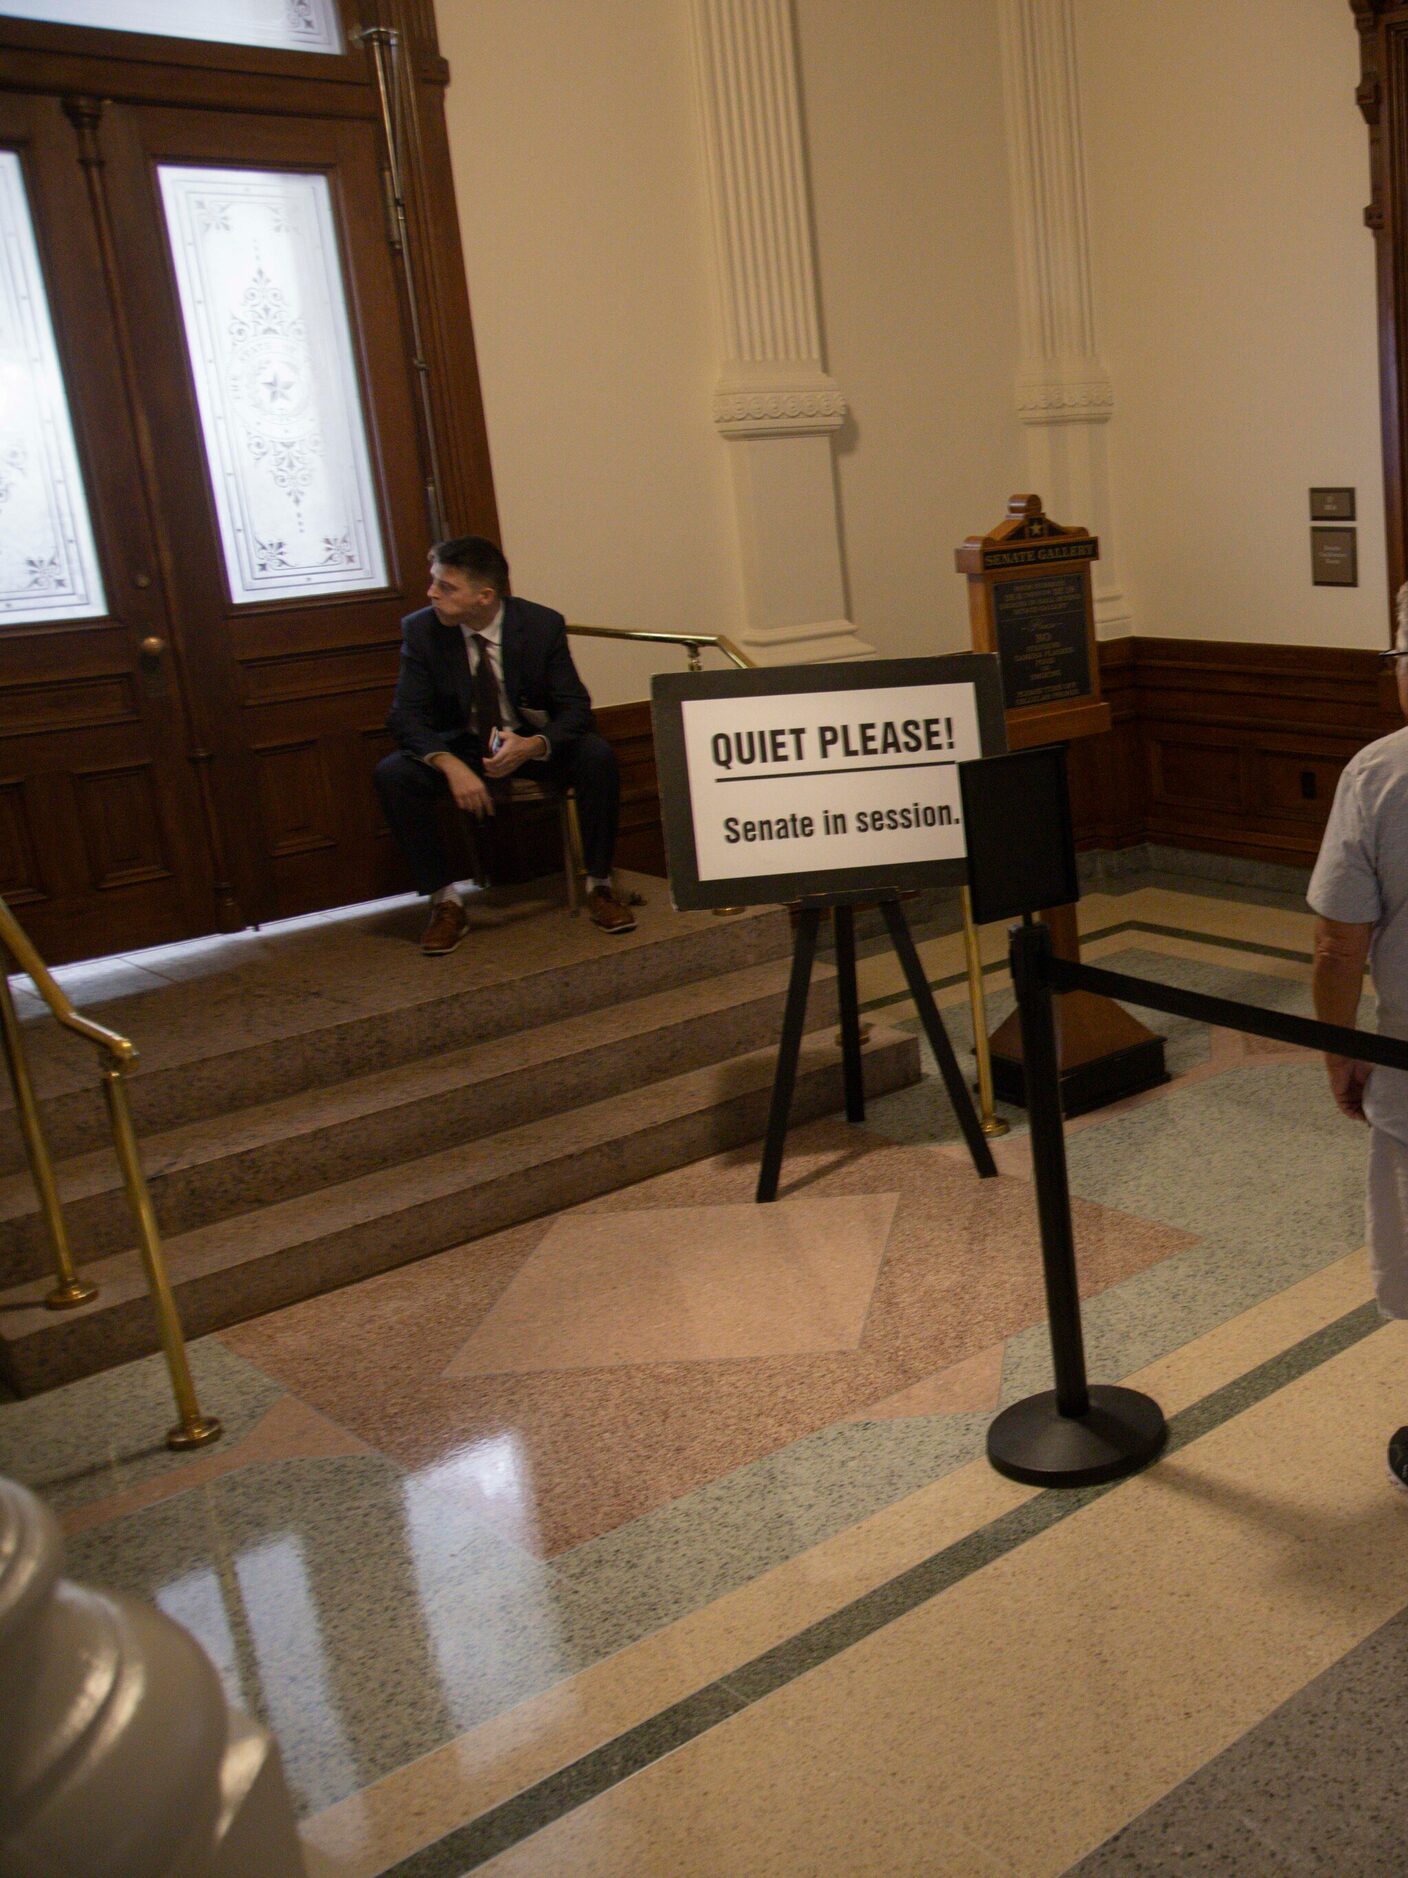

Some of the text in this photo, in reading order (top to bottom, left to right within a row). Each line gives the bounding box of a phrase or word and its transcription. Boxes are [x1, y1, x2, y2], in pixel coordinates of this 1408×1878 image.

[985, 544, 1094, 567] SENATE GALLERY
[712, 717, 955, 769] QUIET PLEASE!
[724, 801, 961, 844] Senate in session.
